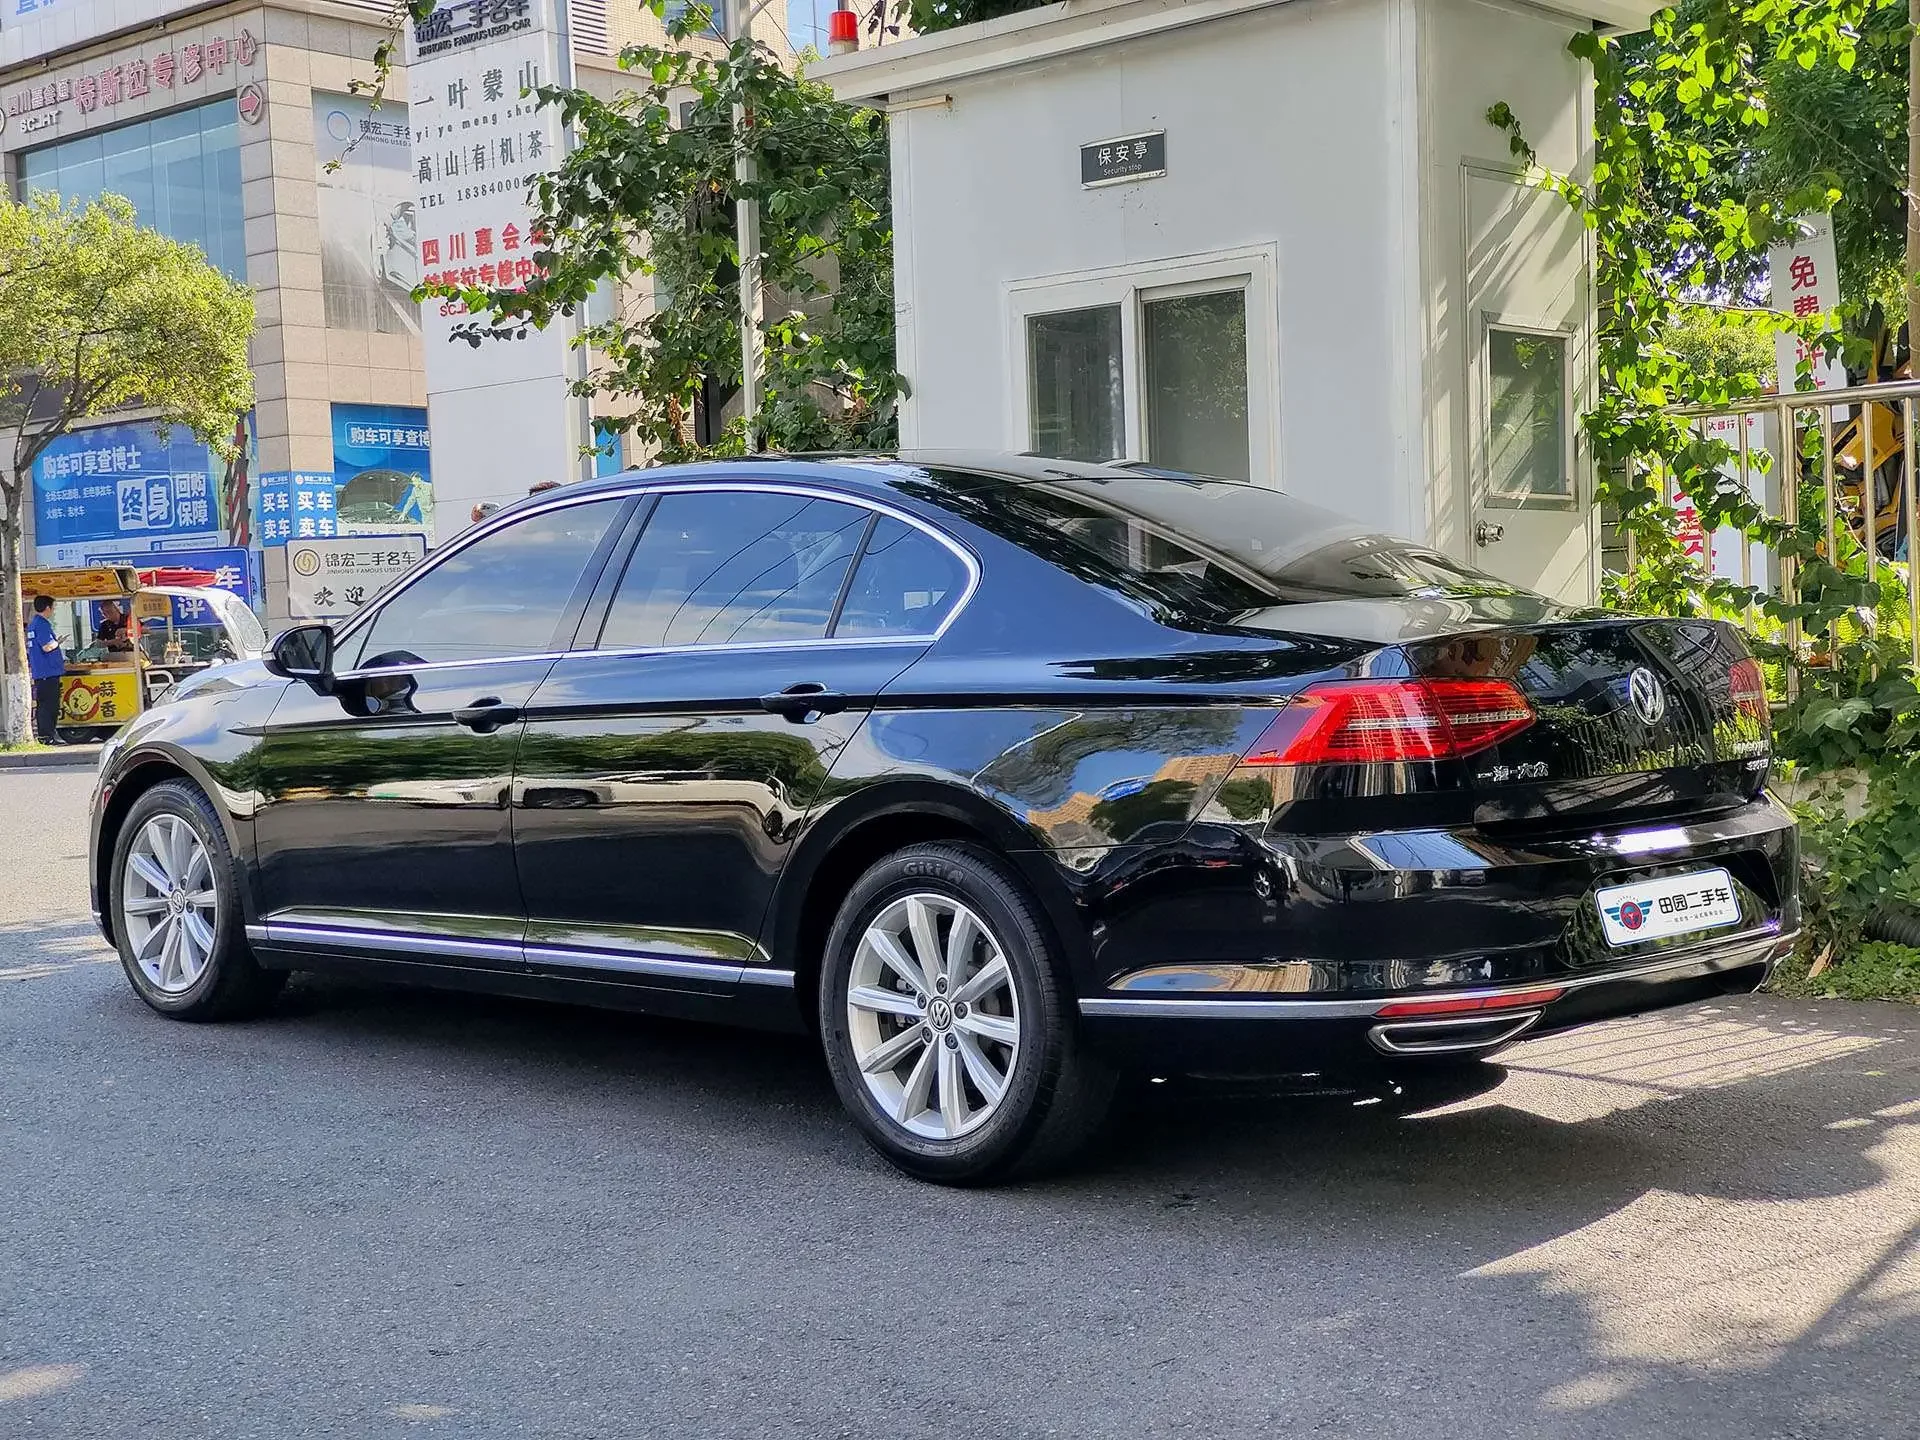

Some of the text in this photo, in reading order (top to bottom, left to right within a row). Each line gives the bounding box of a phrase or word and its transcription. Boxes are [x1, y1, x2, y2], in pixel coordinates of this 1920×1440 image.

[507, 103, 538, 119] sha
[1098, 140, 1148, 166] 保安亭
[420, 193, 445, 209] TEL
[43, 444, 142, 480] 购车可享查博士
[176, 472, 207, 498] 回购
[121, 483, 171, 522] 终身
[263, 491, 290, 513] 买车
[298, 491, 334, 512] 买车
[177, 500, 209, 527] 保障
[265, 517, 291, 539] 卖车
[300, 516, 334, 537] 卖车
[324, 551, 416, 567] 锦宏二手名车
[314, 586, 386, 607] 欢迎
[1659, 888, 1730, 914] 田园二手车
